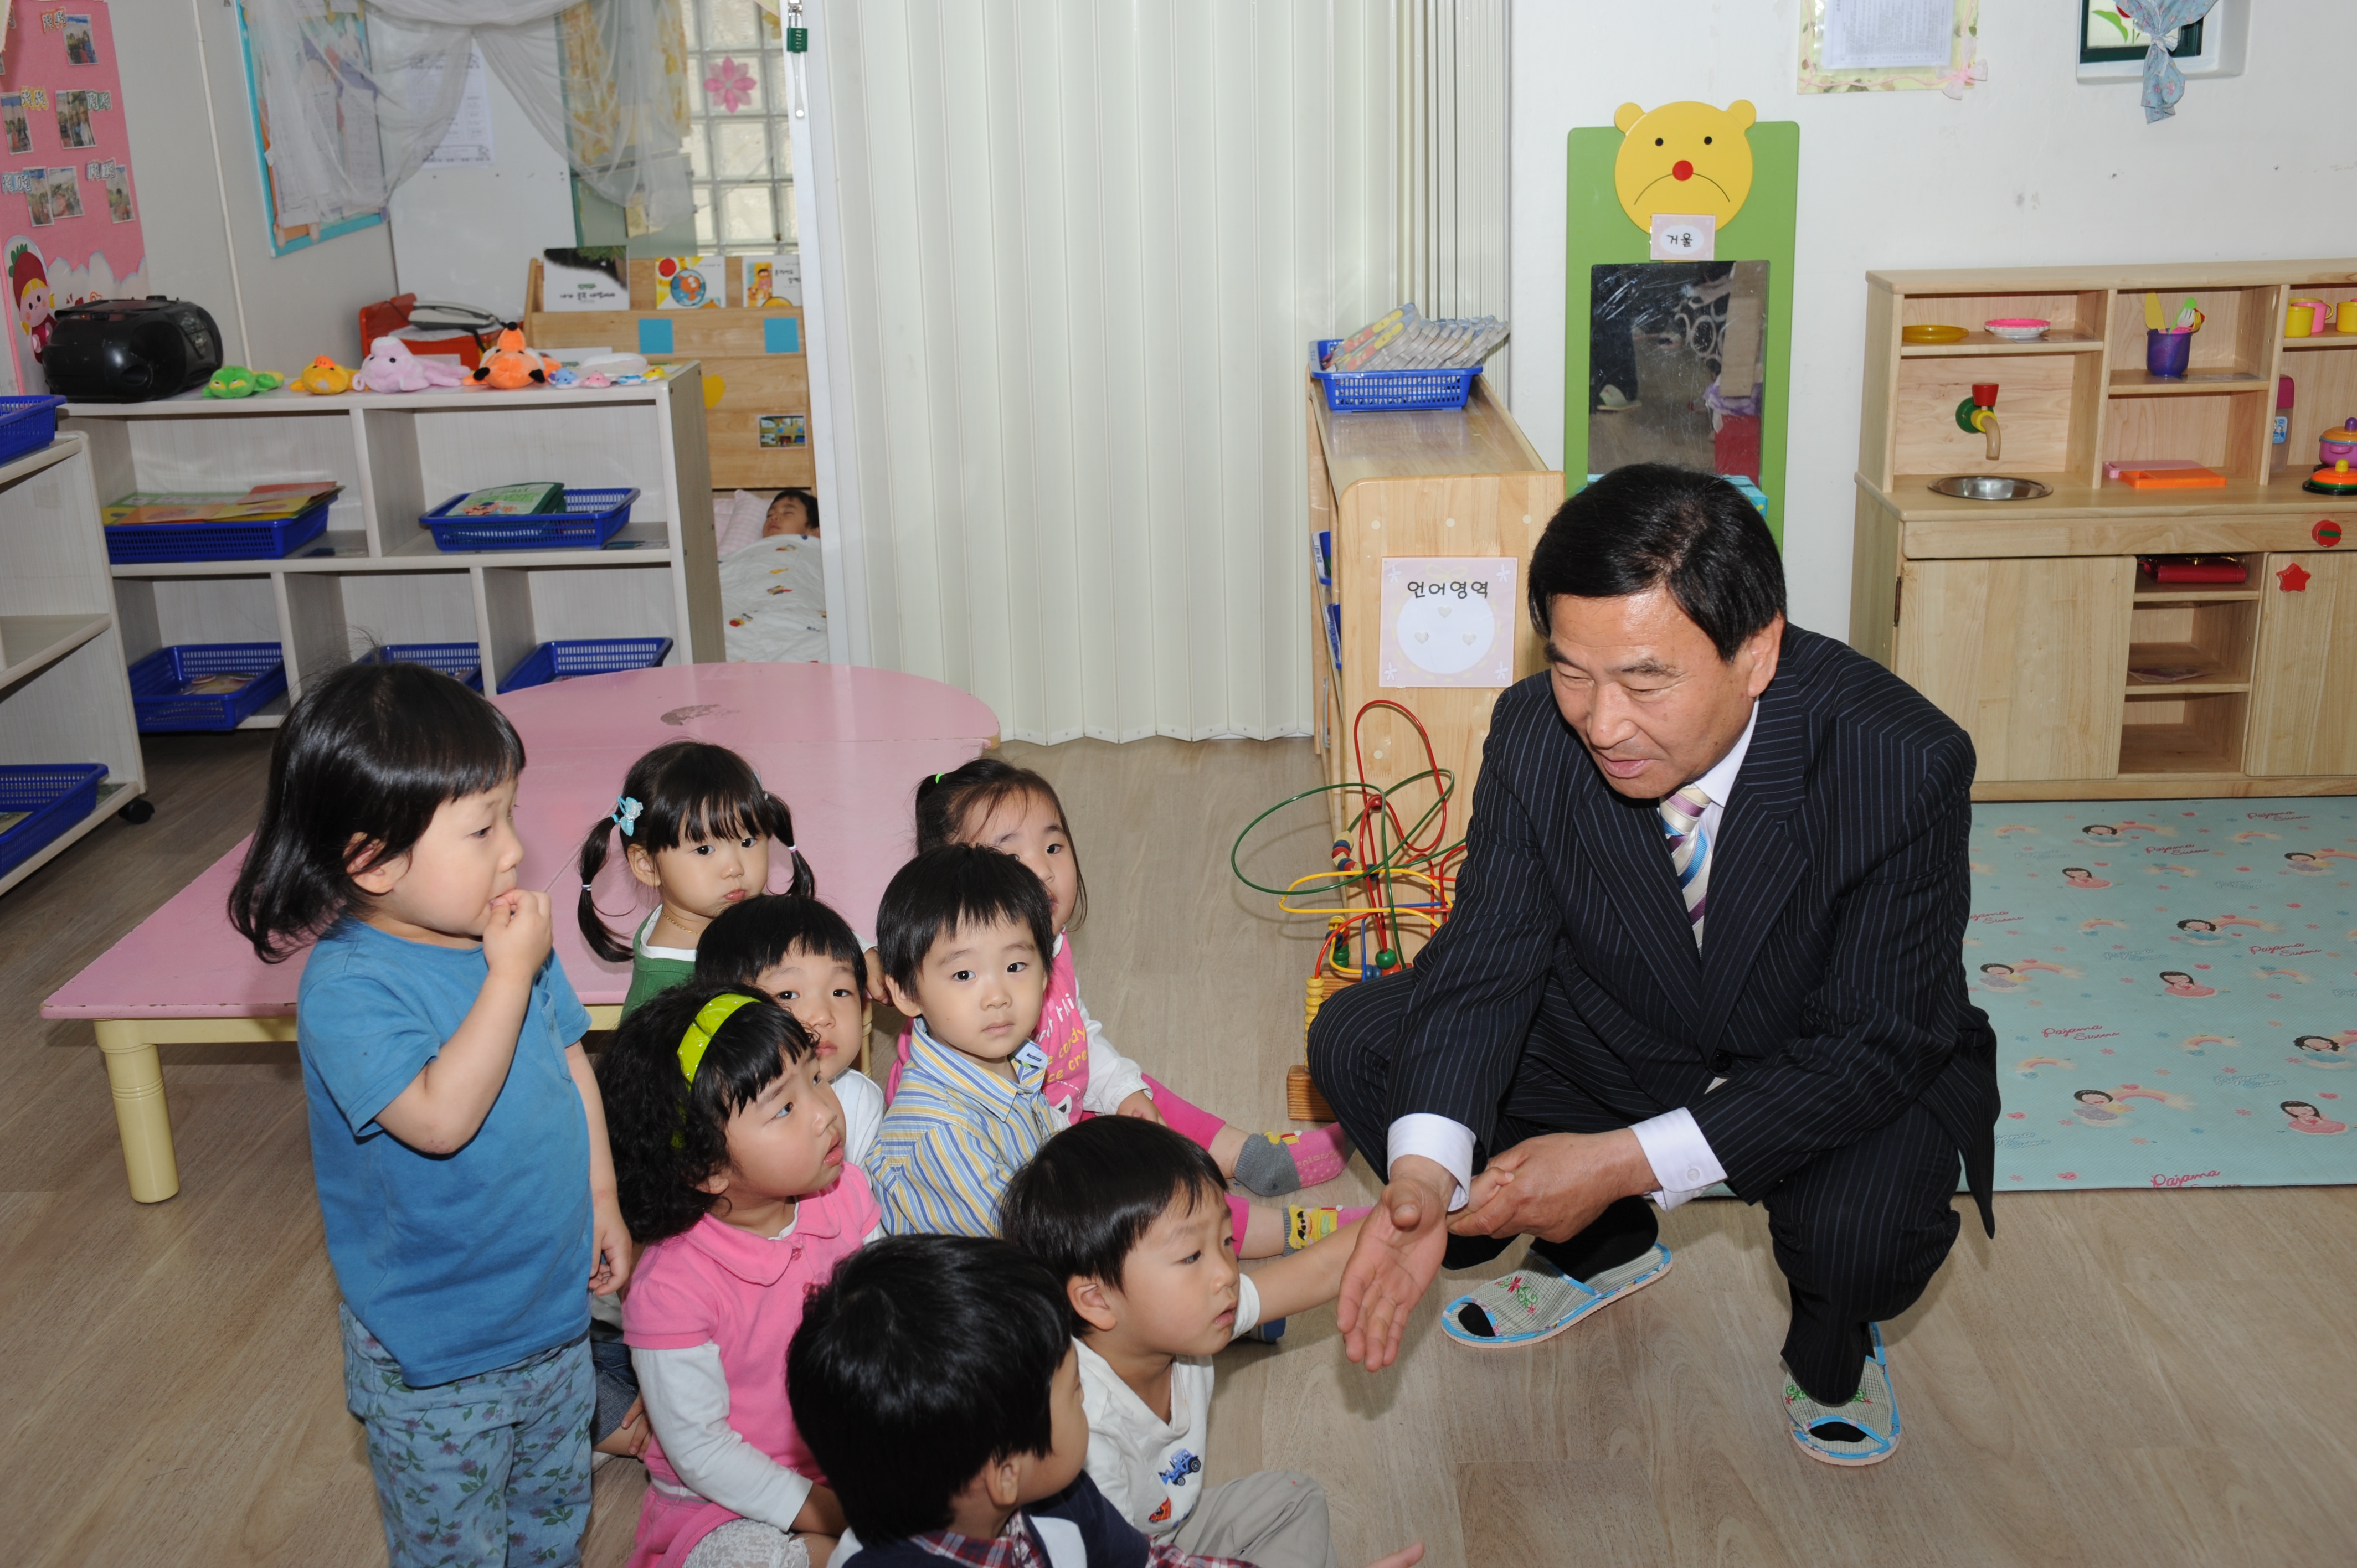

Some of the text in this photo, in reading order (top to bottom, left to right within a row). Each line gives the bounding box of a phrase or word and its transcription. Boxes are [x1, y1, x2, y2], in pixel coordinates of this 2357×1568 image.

[1666, 233, 1693, 247] 거울
[1407, 581, 1488, 599] 언어영역
[2249, 943, 2304, 955] Pajama
[2042, 1025, 2102, 1037] Pajama
[2074, 1032, 2120, 1040] Sisters
[1068, 1050, 1087, 1071] cre
[2151, 1170, 2220, 1188] Pajama
